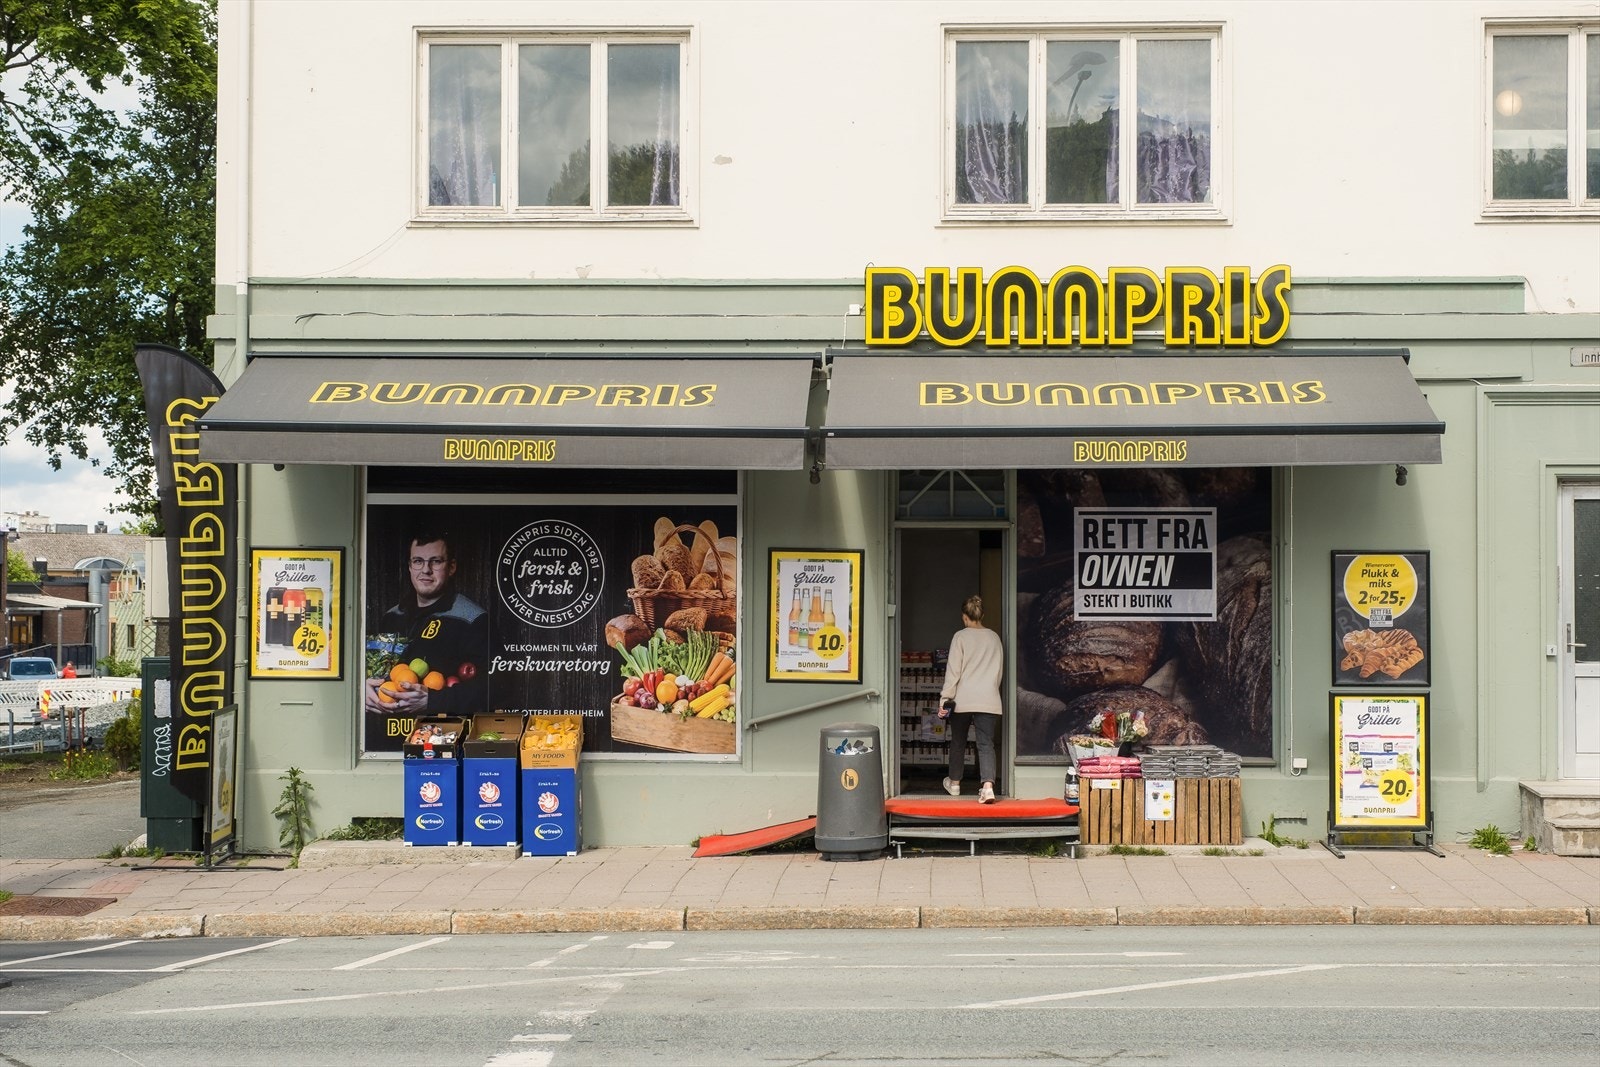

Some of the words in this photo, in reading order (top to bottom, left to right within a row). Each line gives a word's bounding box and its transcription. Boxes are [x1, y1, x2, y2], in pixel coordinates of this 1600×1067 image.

[865, 264, 1292, 346] BUNNPRIS
[309, 382, 718, 407] BUNNPRIS
[919, 381, 1327, 406] BUNNPRIS
[444, 438, 557, 462] BUNNPRIS
[1073, 440, 1187, 462] BUNNPRIS
[1083, 518, 1148, 549] RETT
[1157, 518, 1209, 549] FRA
[502, 524, 551, 565] BUNNPRIS
[553, 525, 588, 546] SIDEN
[585, 546, 600, 569] 1981
[533, 548, 568, 556] ALLTID
[517, 560, 565, 578] fersk
[567, 561, 582, 576] &
[1081, 554, 1175, 587] OVNEN
[1361, 569, 1389, 578] Plukk
[1391, 569, 1400, 578] &
[275, 571, 317, 586] Grillen
[794, 572, 836, 587] Grillen
[1369, 579, 1392, 588] miks
[527, 579, 574, 598] frisk
[1358, 590, 1368, 605] 2
[1369, 594, 1380, 603] for
[507, 593, 532, 618] HVER
[534, 609, 575, 623] ENESTE
[574, 592, 594, 614] DAG
[1083, 594, 1119, 608] STEKT
[1123, 594, 1126, 608] I
[1130, 594, 1173, 608] BUTIKK
[302, 627, 309, 638] 3
[309, 629, 319, 639] for
[504, 644, 560, 652] VELKOMMEN
[562, 644, 574, 652] TIL
[575, 642, 598, 652] VÅRT
[488, 655, 611, 675] ferskvaretorg
[1357, 713, 1402, 730] Grillen
